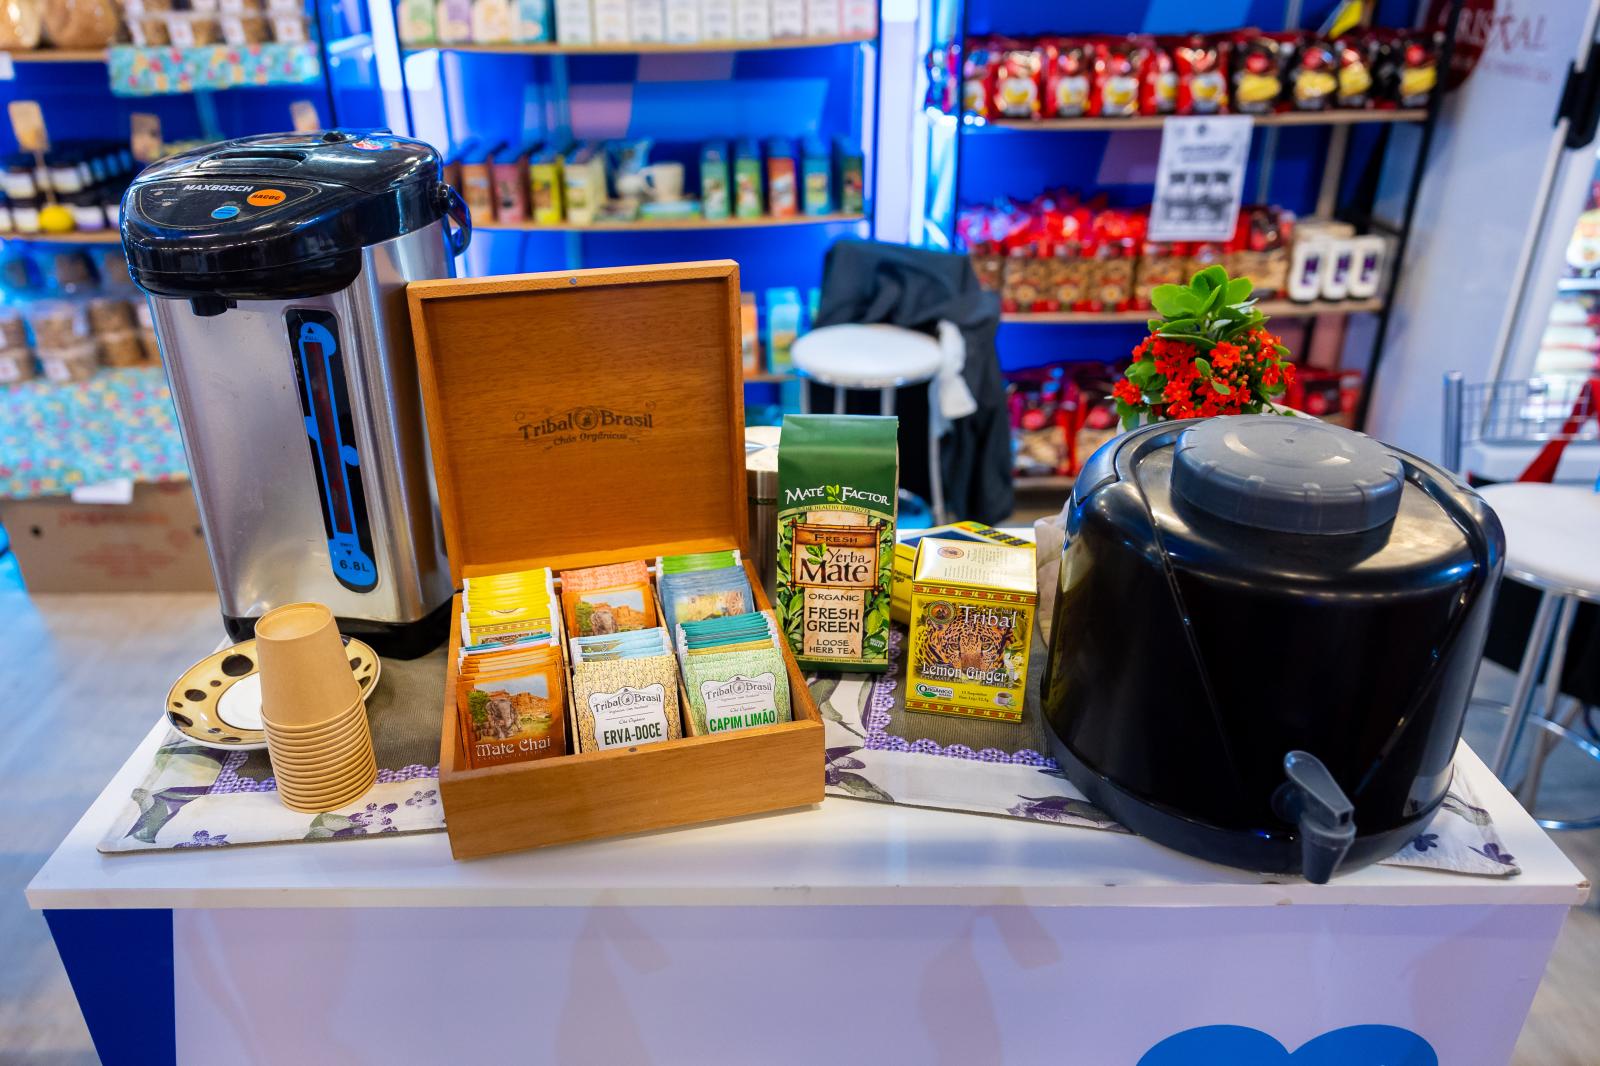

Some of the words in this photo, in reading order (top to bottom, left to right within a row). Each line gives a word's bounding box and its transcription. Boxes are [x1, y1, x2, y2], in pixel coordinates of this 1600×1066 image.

[182, 184, 254, 192] MAXBOSCH
[518, 412, 574, 441] Tribal
[600, 409, 653, 429] Brasil
[841, 486, 891, 506] FACTOR
[814, 533, 858, 543] FRESH
[826, 548, 865, 564] Yerba
[799, 557, 872, 584] Maté
[808, 593, 860, 602] ORGANIC
[808, 606, 859, 620] FRESH
[958, 605, 1018, 628] Tribal
[806, 620, 860, 633] GREEN
[809, 646, 834, 654] HERB
[837, 647, 856, 655] TEA
[816, 639, 850, 647] LOOSE
[922, 661, 962, 678] Lemon
[966, 666, 1007, 684] Ginger
[705, 684, 733, 700] Tribal
[745, 681, 772, 691] Brasil
[593, 696, 621, 713] Tribal
[634, 693, 662, 703] Brasil
[709, 715, 743, 732] CAPIM
[745, 708, 776, 727] LIMÃO
[603, 722, 662, 746] ERVA-DOCE
[476, 742, 515, 757] Mate
[519, 735, 551, 752] Chai
